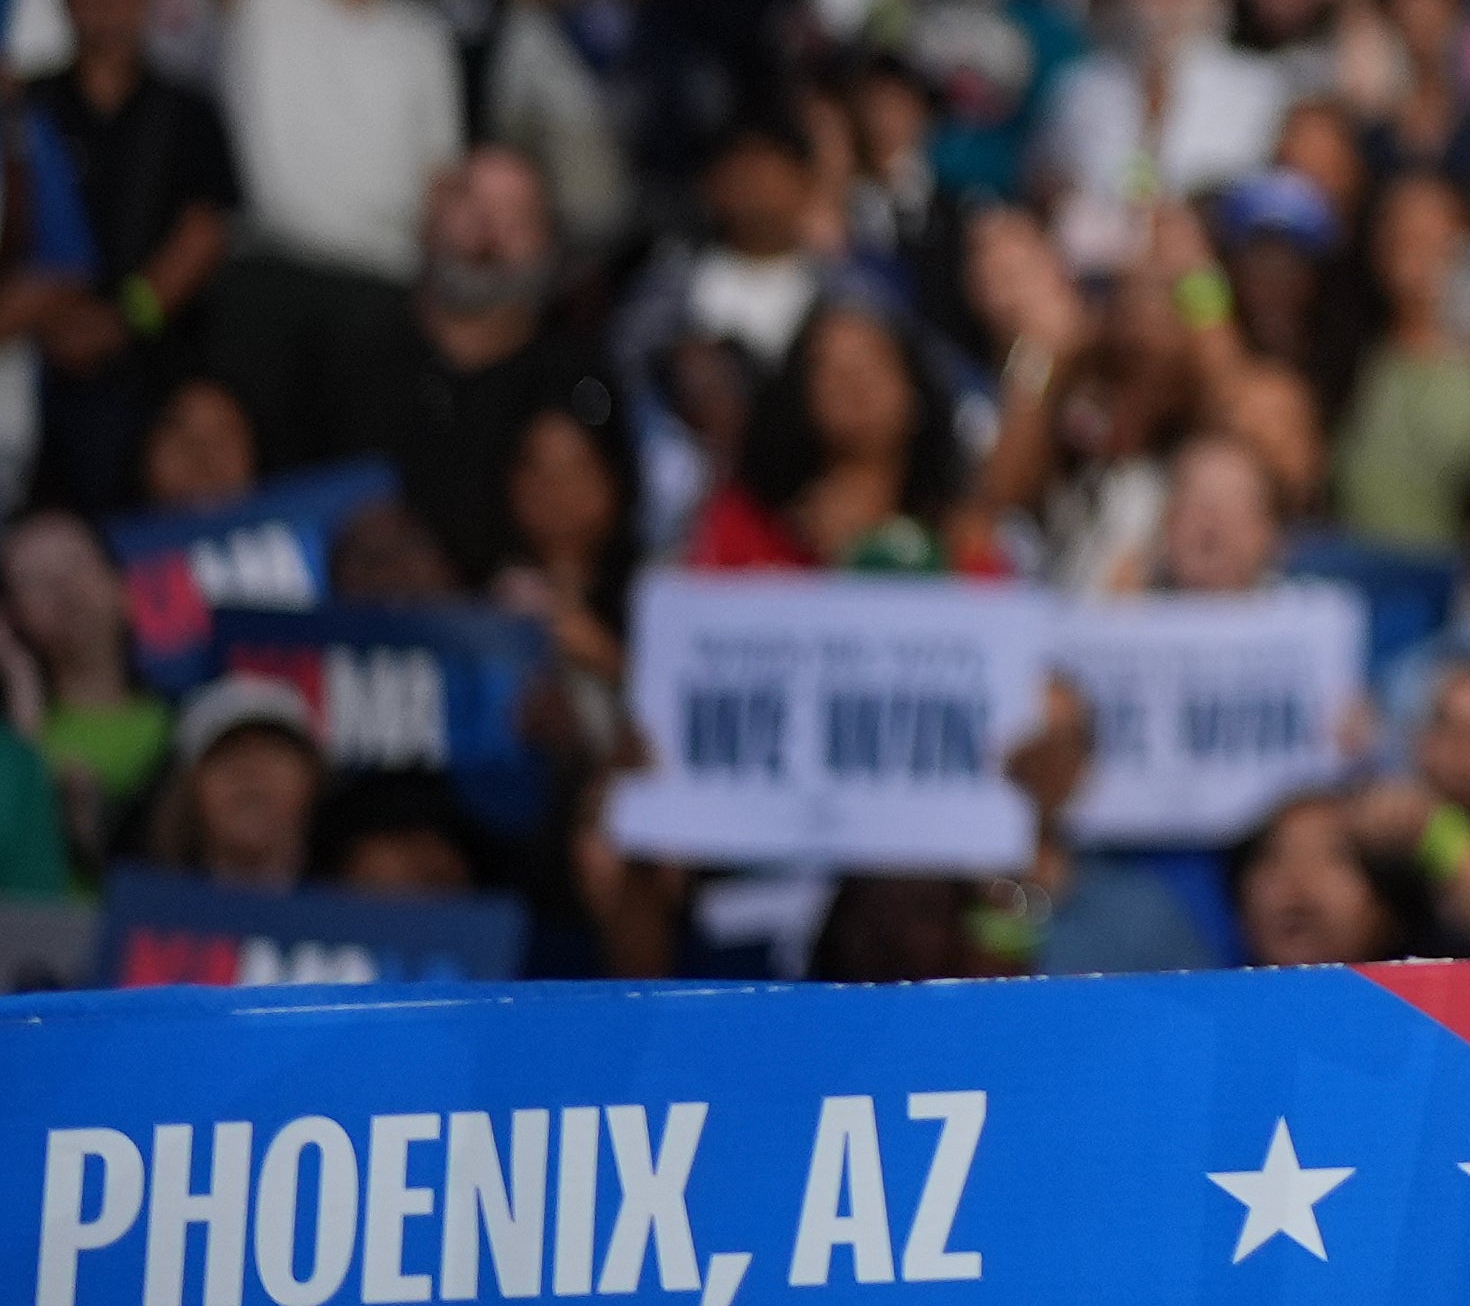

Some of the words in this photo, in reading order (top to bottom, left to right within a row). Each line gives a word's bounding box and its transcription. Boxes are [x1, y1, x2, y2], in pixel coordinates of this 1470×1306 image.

[684, 690, 788, 779] WE
[822, 690, 985, 780] WIN
[36, 1102, 752, 1306] PHOENIX,
[789, 1090, 987, 1286] AZ
